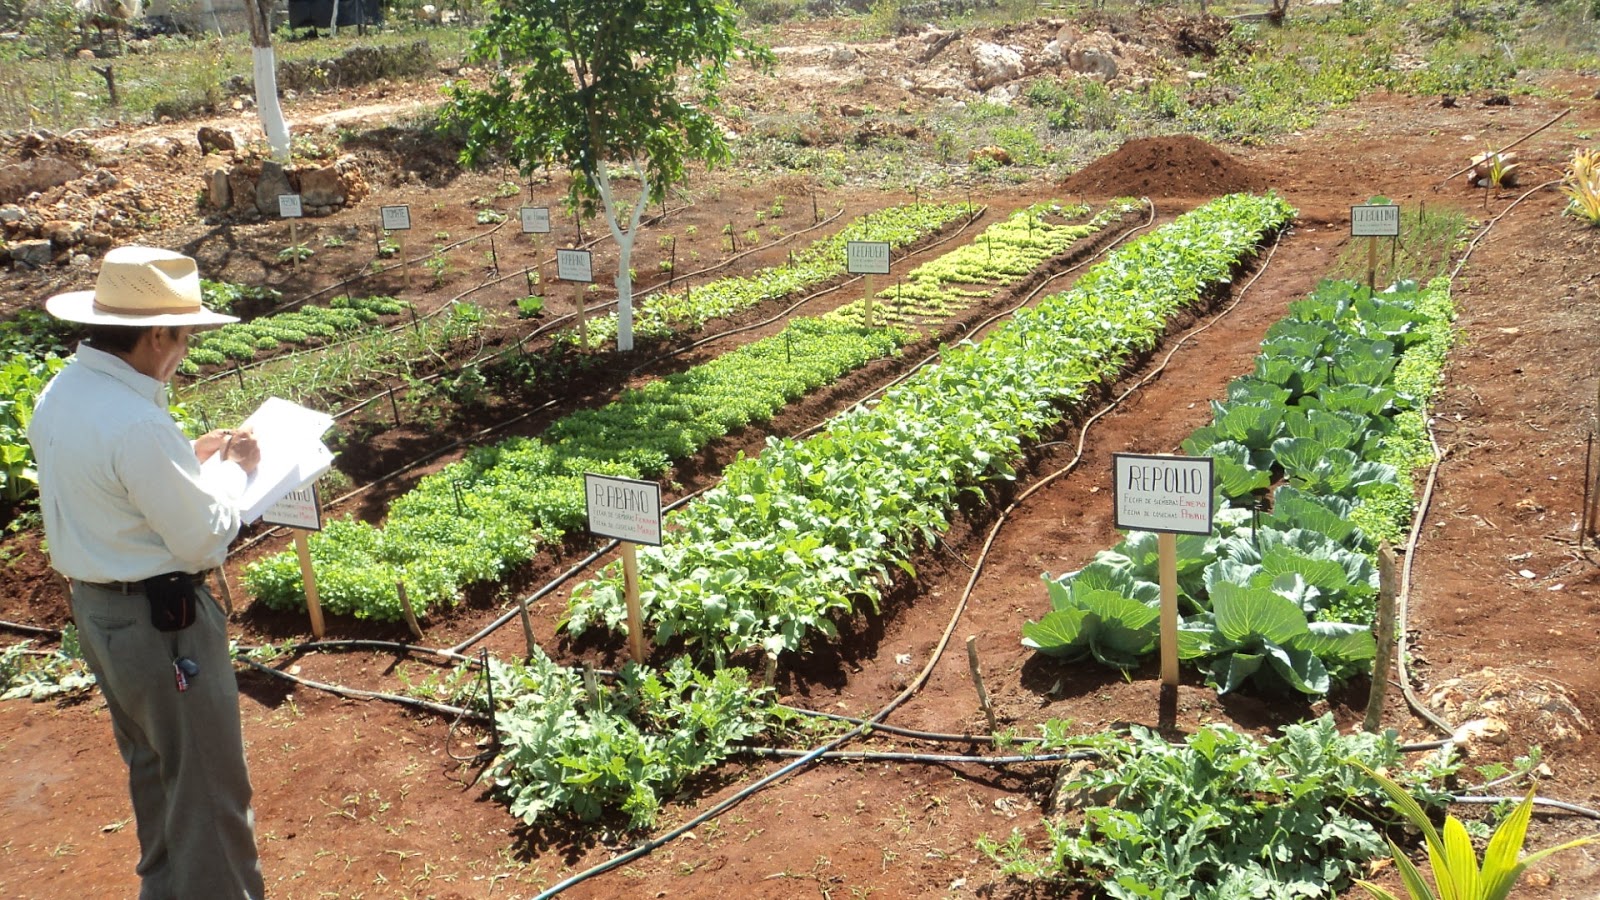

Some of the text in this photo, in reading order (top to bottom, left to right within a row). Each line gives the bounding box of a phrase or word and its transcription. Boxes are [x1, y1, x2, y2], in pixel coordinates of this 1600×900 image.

[852, 245, 886, 258] LECHUGA
[1128, 465, 1202, 494] REPOLLO
[594, 484, 649, 513] RABANO
[1123, 493, 1143, 504] FECHA
[1180, 495, 1206, 507] ENERO
[1123, 505, 1141, 516] FECHA
[1181, 508, 1207, 520] ABRIL
